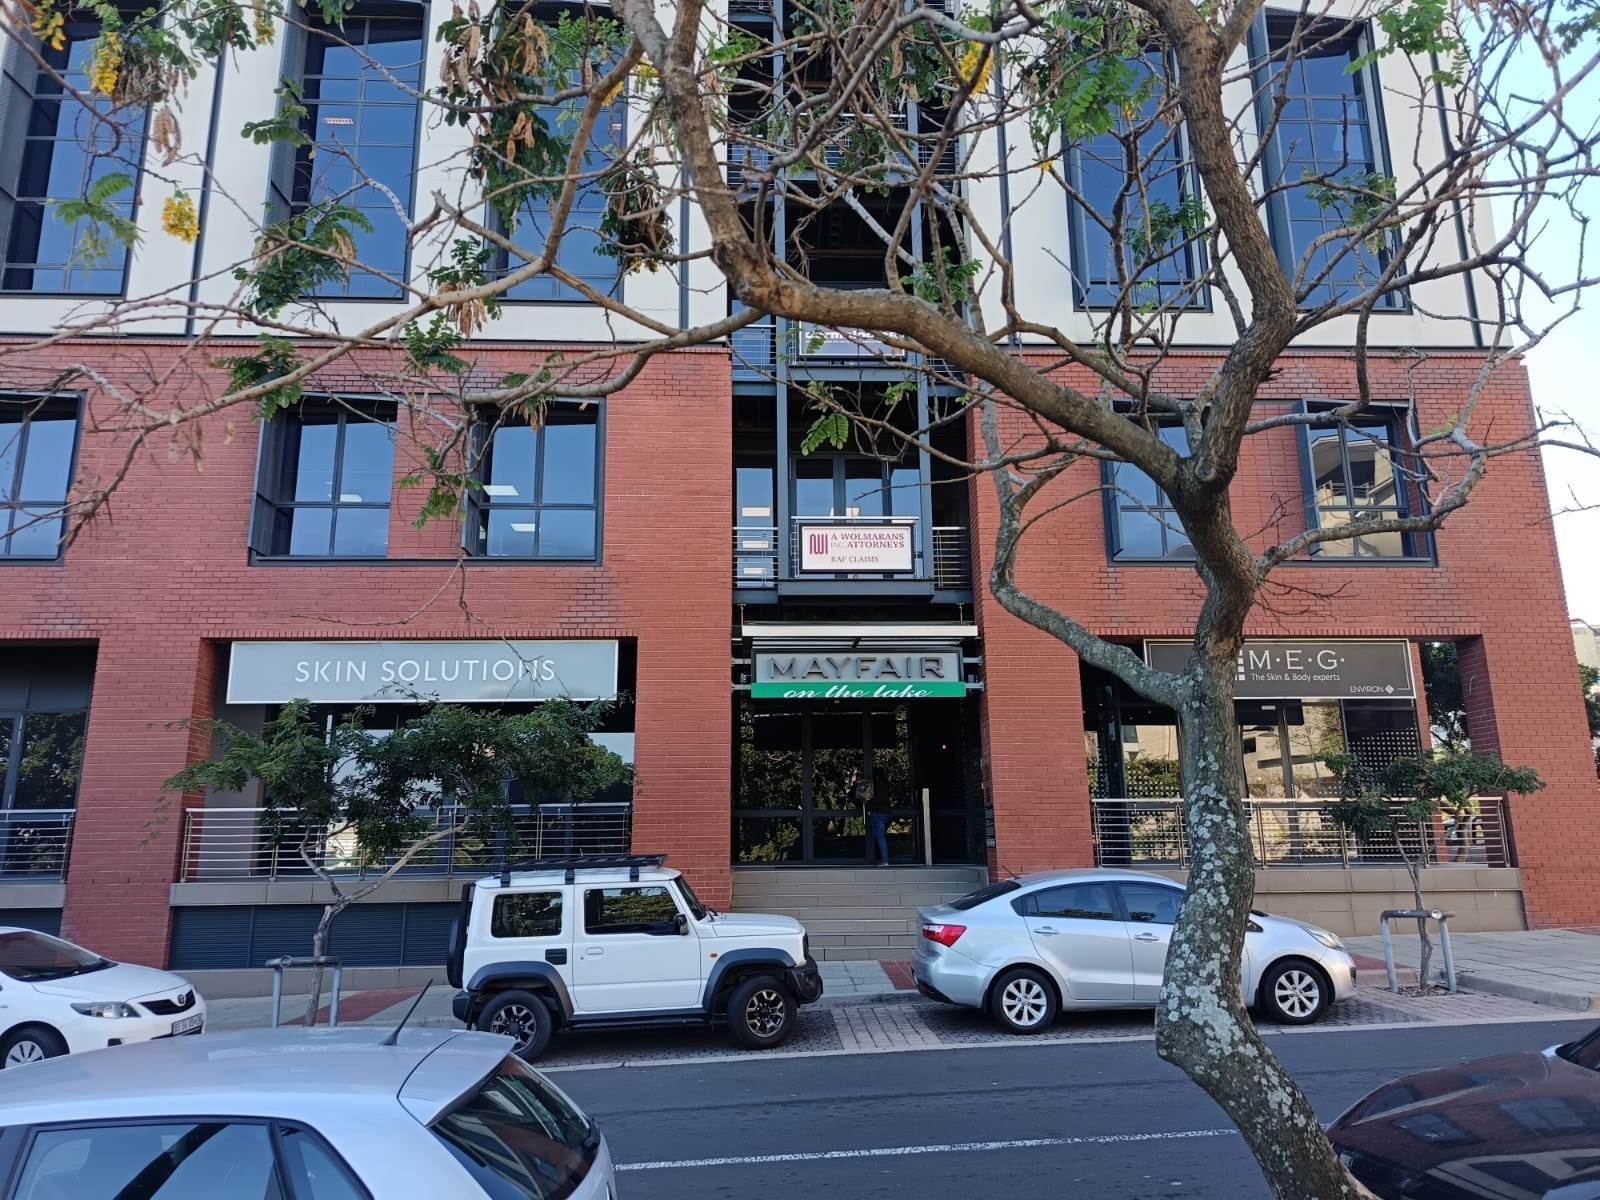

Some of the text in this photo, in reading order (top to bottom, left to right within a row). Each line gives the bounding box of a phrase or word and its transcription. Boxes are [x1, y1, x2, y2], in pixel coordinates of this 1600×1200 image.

[295, 659, 555, 682] SKIN SOLUTIONS
[769, 657, 944, 679] MAYFAIR
[1292, 674, 1311, 683] Body
[1312, 674, 1341, 683] experts
[783, 684, 934, 699] on the lake
